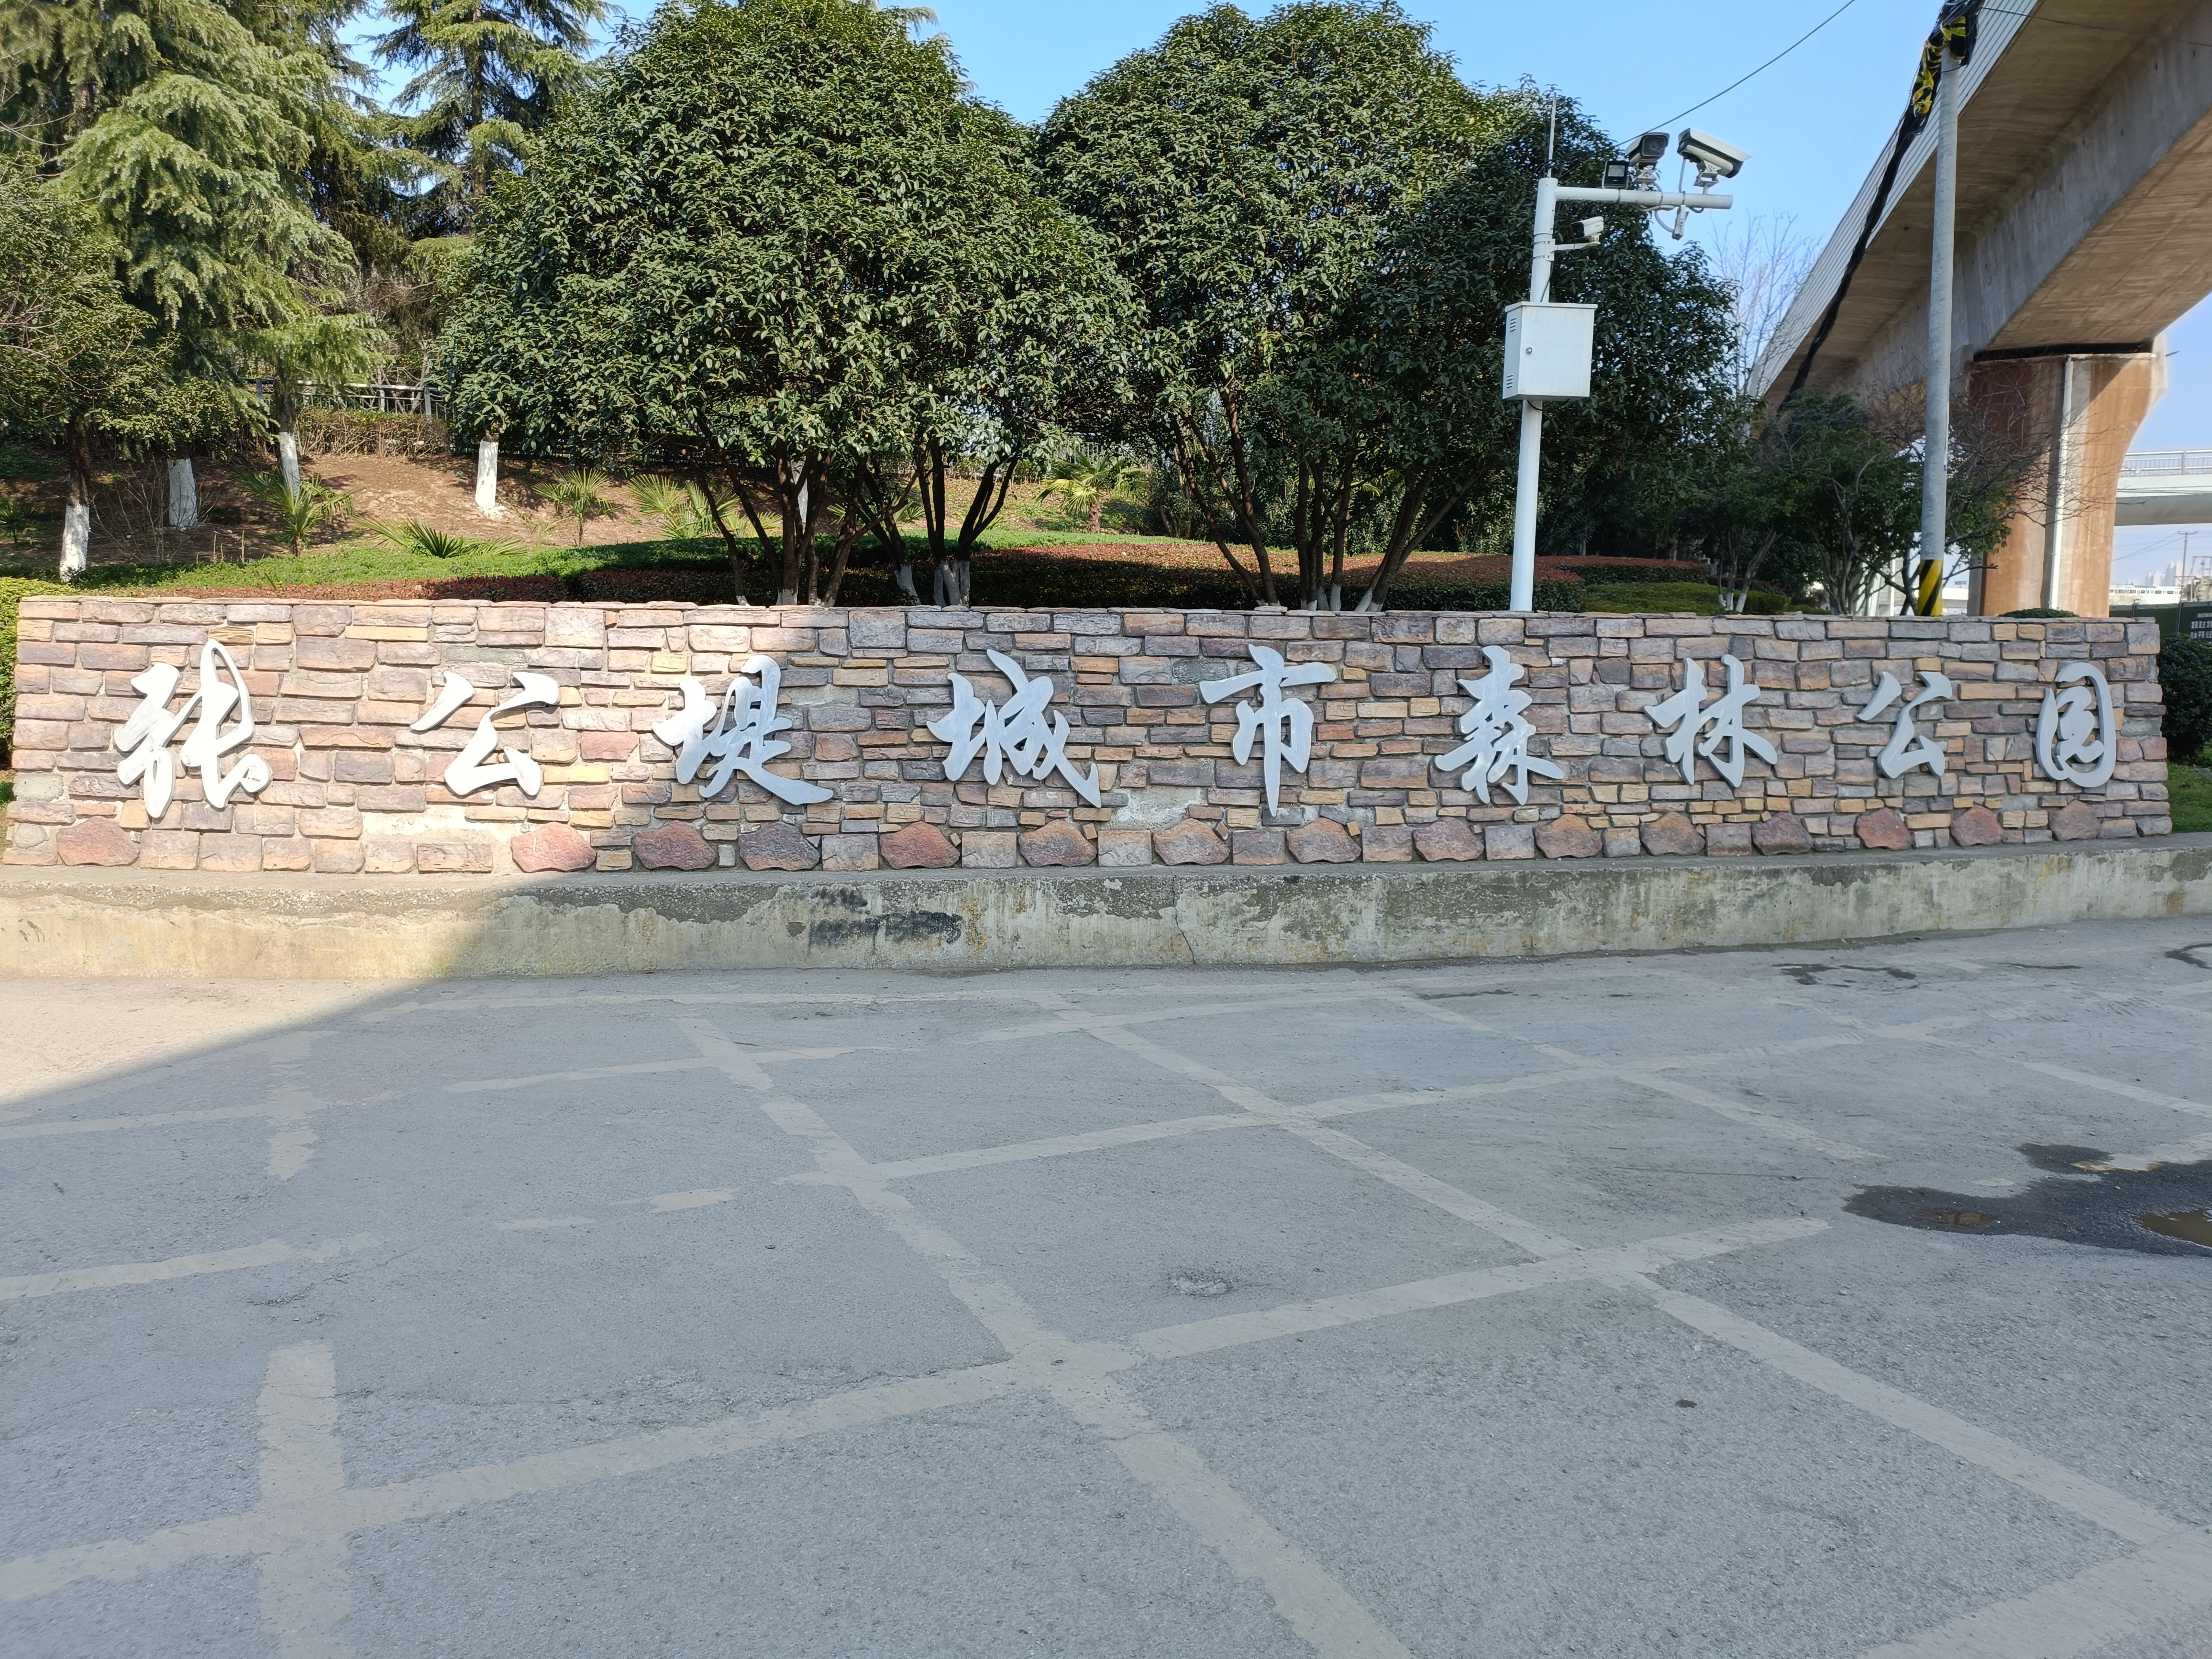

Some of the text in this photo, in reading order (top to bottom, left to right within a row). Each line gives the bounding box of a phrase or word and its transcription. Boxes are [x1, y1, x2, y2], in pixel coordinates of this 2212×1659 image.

[113, 638, 2117, 818] 张公堤城市森林公园
